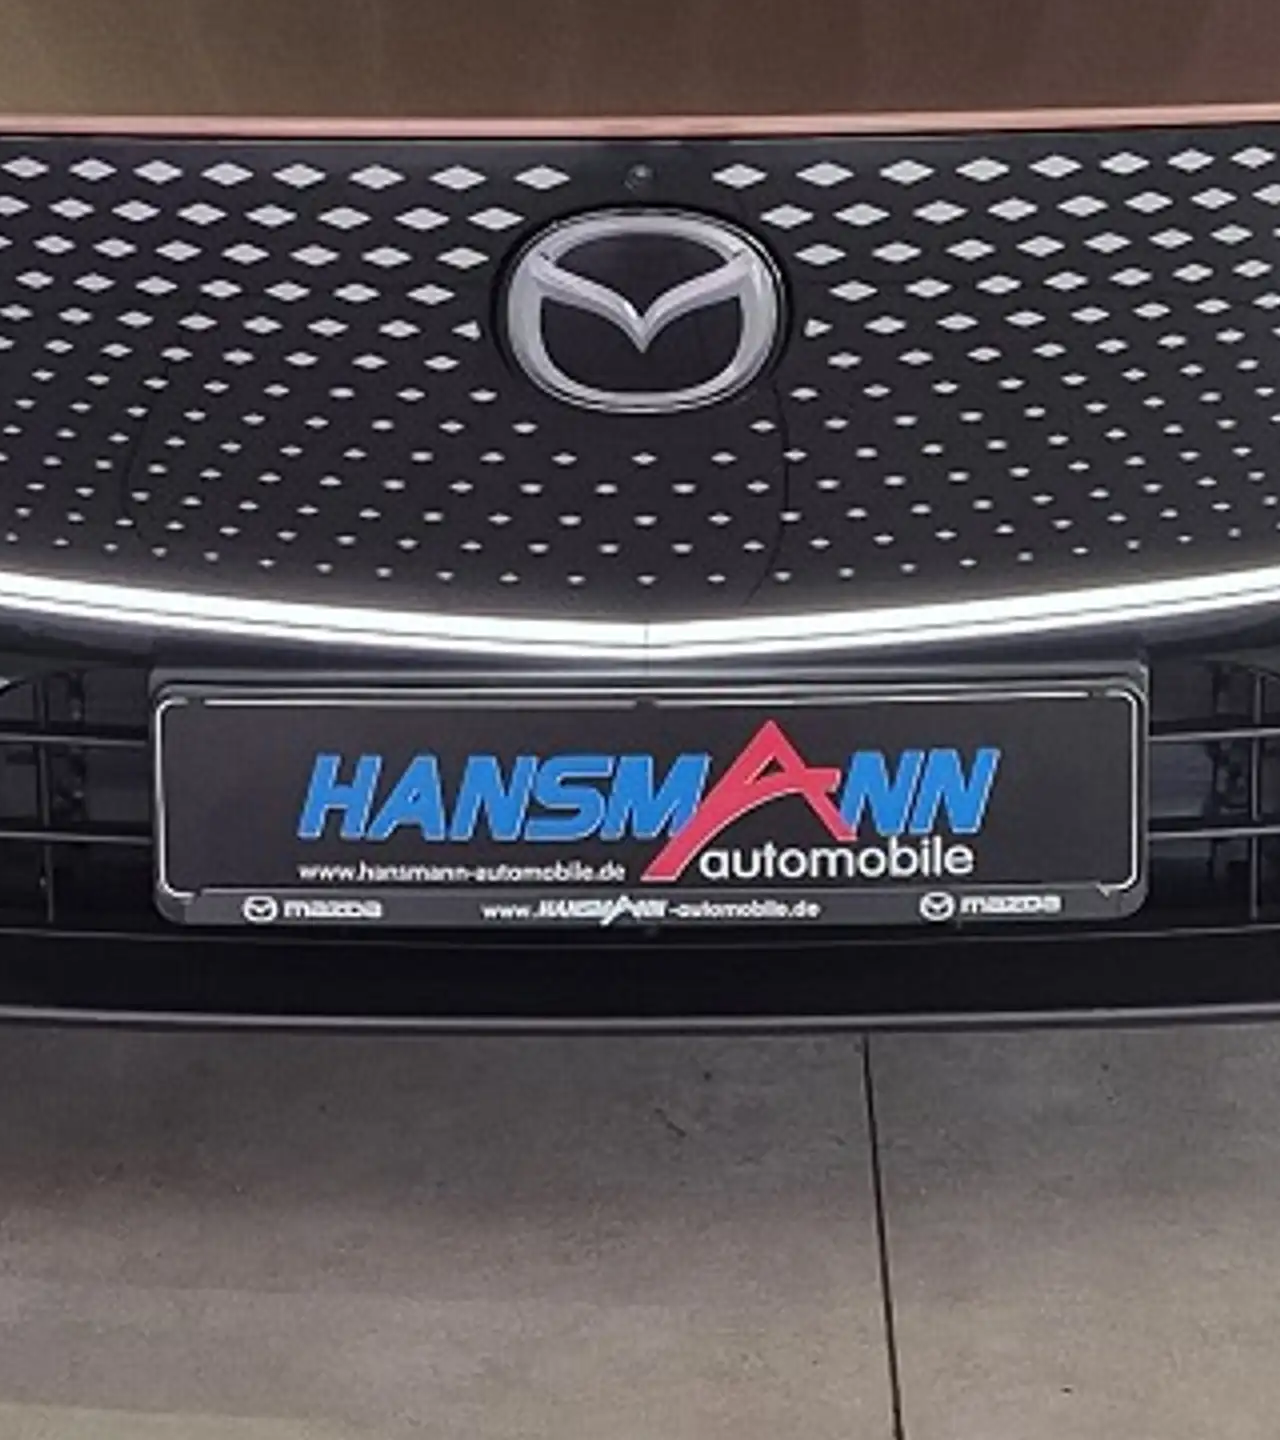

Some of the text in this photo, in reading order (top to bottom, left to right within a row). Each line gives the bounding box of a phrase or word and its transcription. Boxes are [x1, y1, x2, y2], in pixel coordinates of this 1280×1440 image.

[298, 720, 1000, 881] HANSMANN
[298, 861, 626, 883] www.hansmann-automobile.de
[699, 834, 974, 881] automobile
